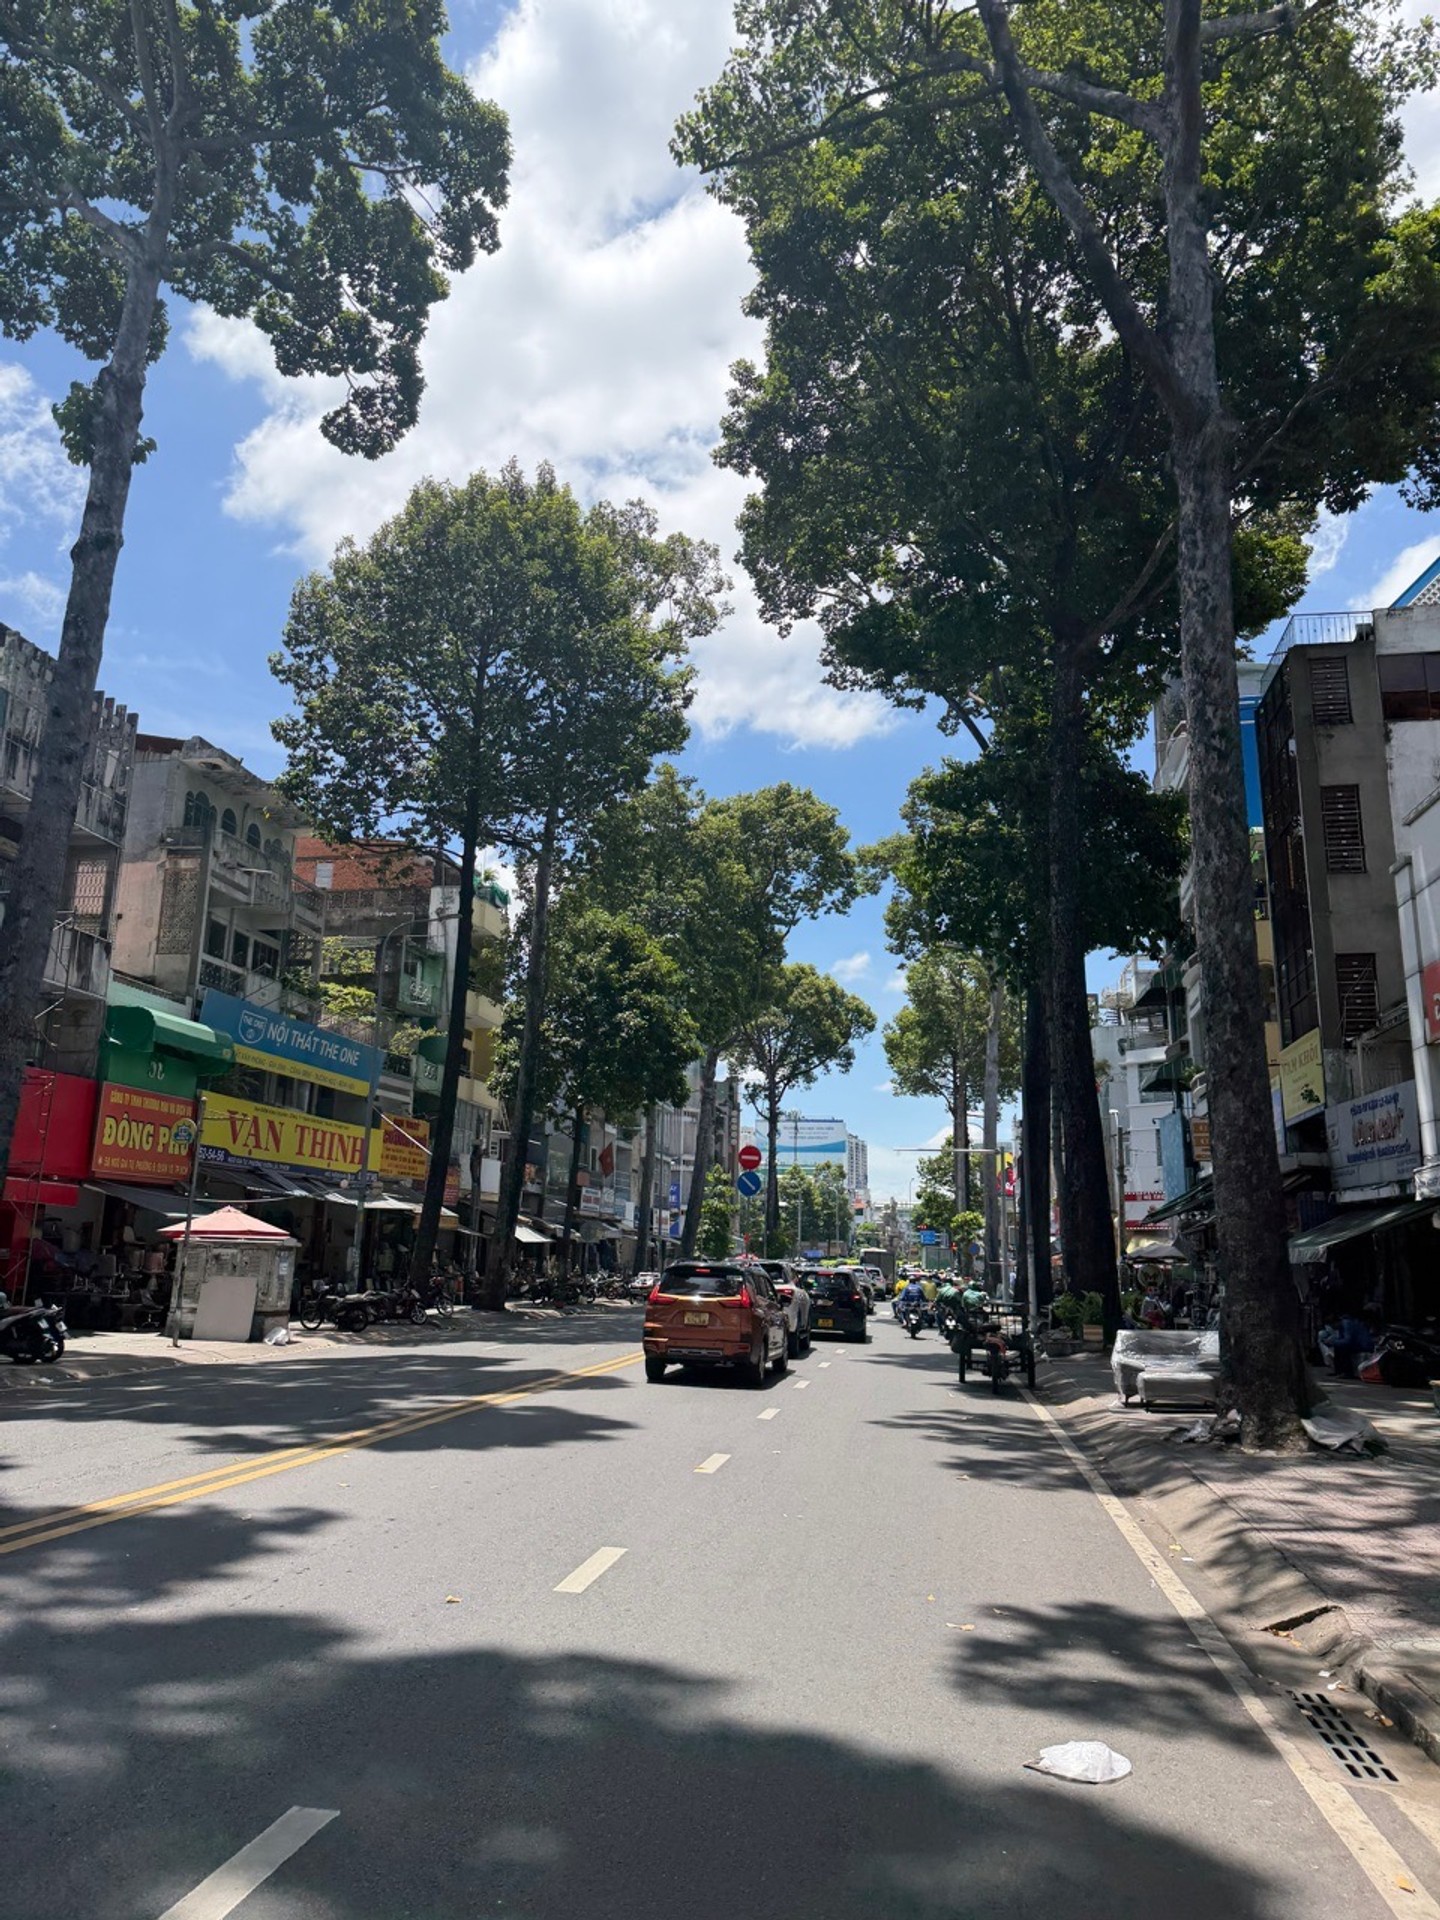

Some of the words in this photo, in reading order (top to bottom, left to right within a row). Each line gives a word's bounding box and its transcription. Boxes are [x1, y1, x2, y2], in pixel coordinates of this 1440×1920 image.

[266, 1021, 290, 1047] NỘI
[290, 1029, 321, 1053] THẤT
[320, 1039, 341, 1060] THE
[340, 1046, 360, 1067] ONE
[102, 1112, 155, 1151] ĐÔNG
[227, 1109, 285, 1156] VẠN
[295, 1123, 366, 1168] THỊNH
